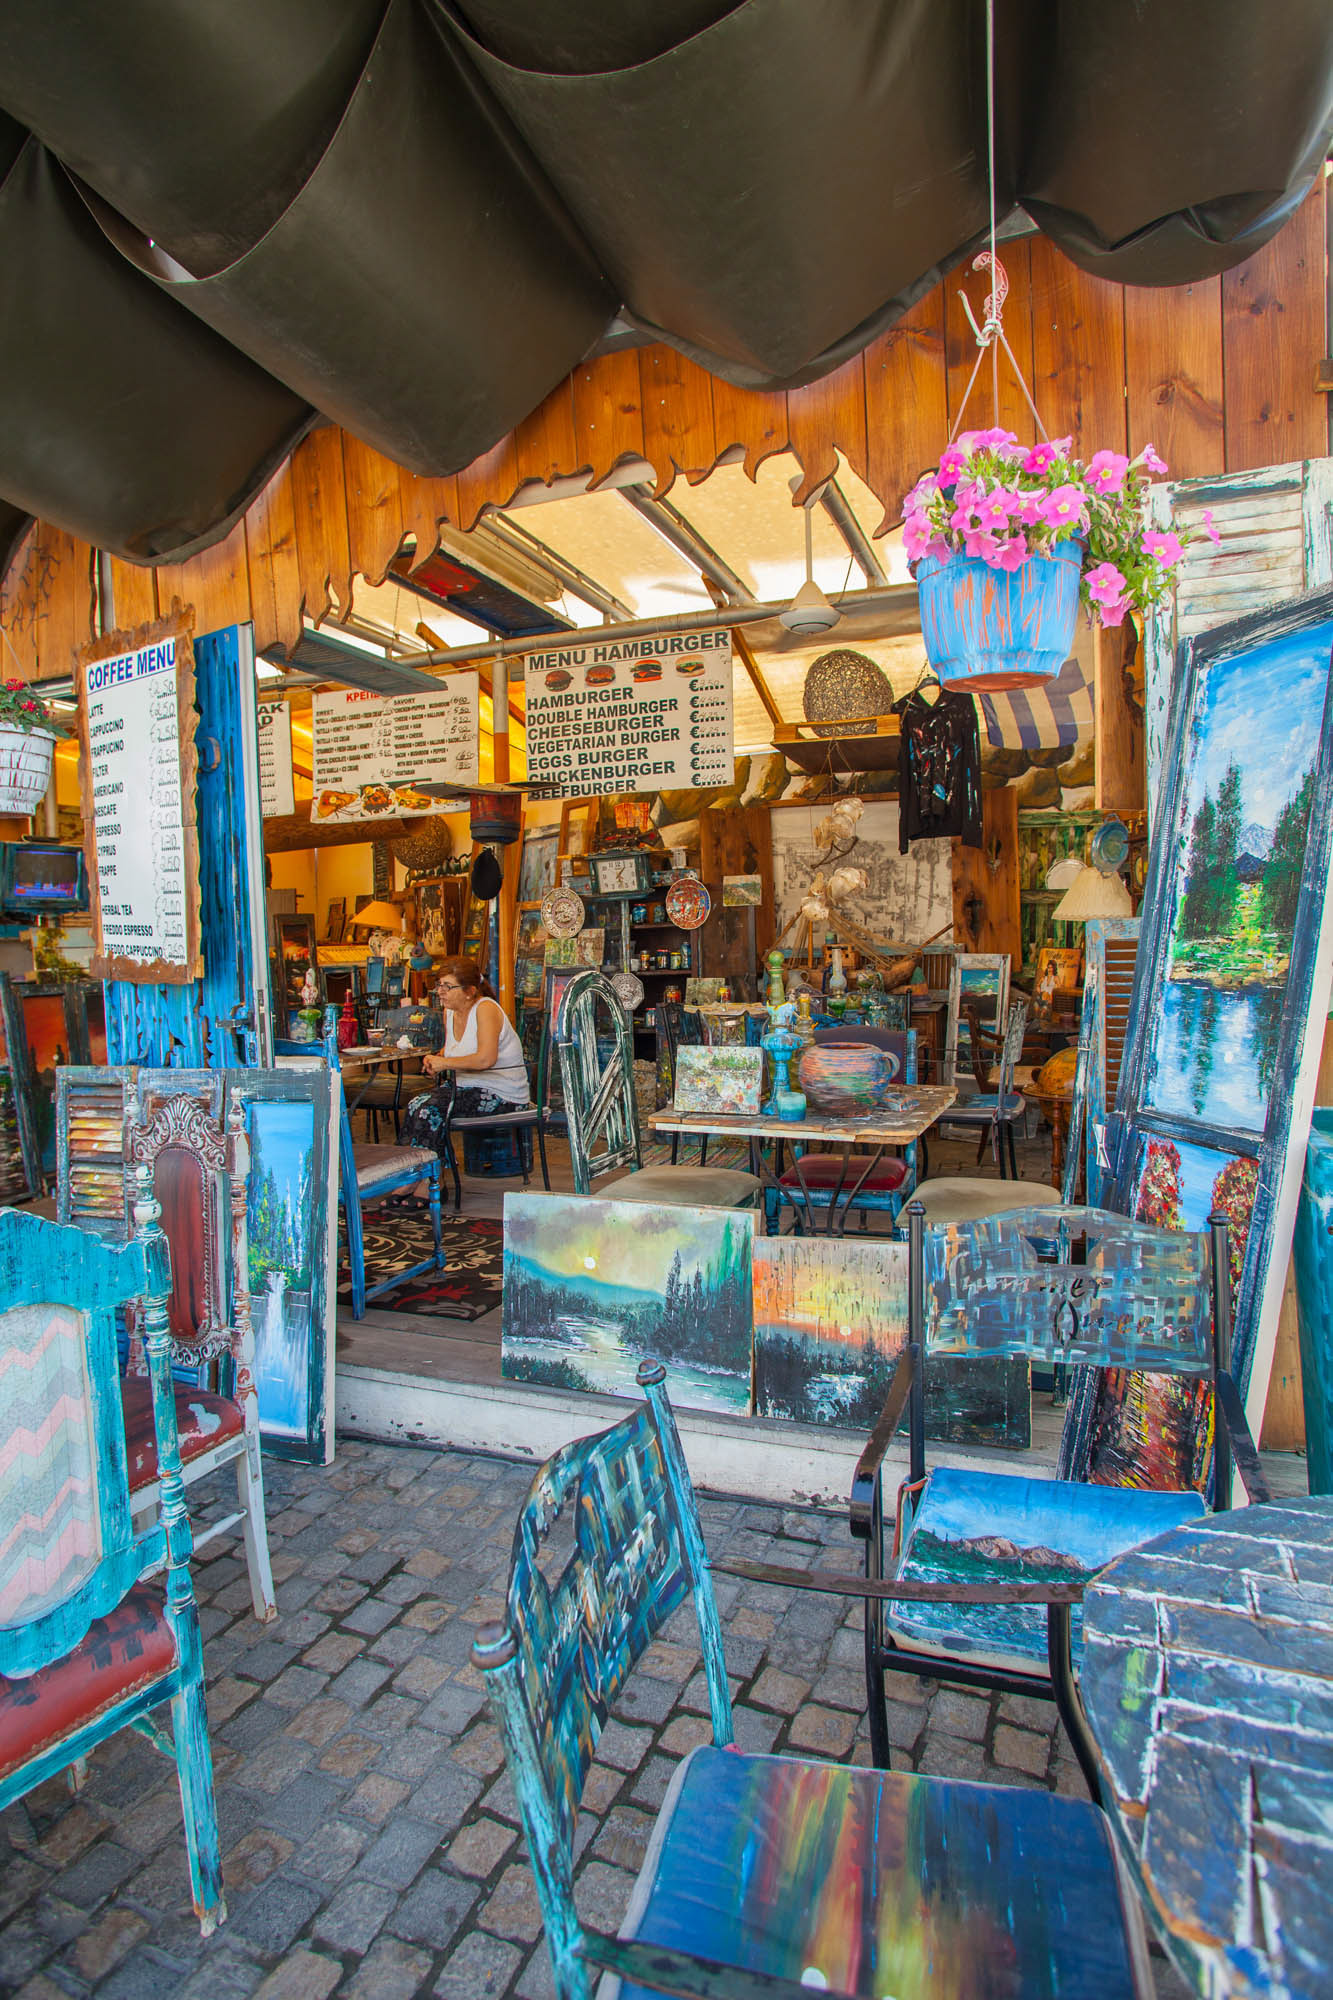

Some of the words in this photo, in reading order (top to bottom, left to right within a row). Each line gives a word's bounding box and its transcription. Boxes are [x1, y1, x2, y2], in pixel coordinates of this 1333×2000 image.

[529, 650, 586, 671] MENU
[593, 631, 729, 663] HAMBURGER
[88, 657, 132, 690] COFFEE
[137, 641, 175, 675] MENU
[527, 687, 633, 711] HAMBURGER
[89, 704, 103, 719] LATTE
[527, 709, 582, 726] DOUBLE
[587, 699, 678, 720] HAMBURGER
[90, 719, 123, 738] CAPPUCCINO
[528, 715, 664, 740] CHEESEBURGER
[528, 735, 616, 755] VEGETARIAN
[621, 728, 680, 745] BURGER
[529, 754, 572, 771] EGGS
[578, 747, 648, 765] BURGER
[93, 764, 108, 777] FILTER
[529, 760, 675, 784] CHICKENBURGER
[94, 782, 123, 797] AMERICANO
[530, 779, 636, 800] BEEFBURGER
[95, 804, 116, 816] NESCAFE
[97, 824, 121, 837] ESPRESSO
[98, 845, 116, 856] CYPRUS
[99, 865, 116, 876] FRAPPE
[100, 886, 109, 896] TEA
[102, 905, 120, 915] HERBAL
[122, 905, 132, 915] TEA
[104, 925, 122, 935] FREDDO
[124, 925, 153, 936] ESPRESSO
[126, 944, 163, 957] CAPPUCCINO
